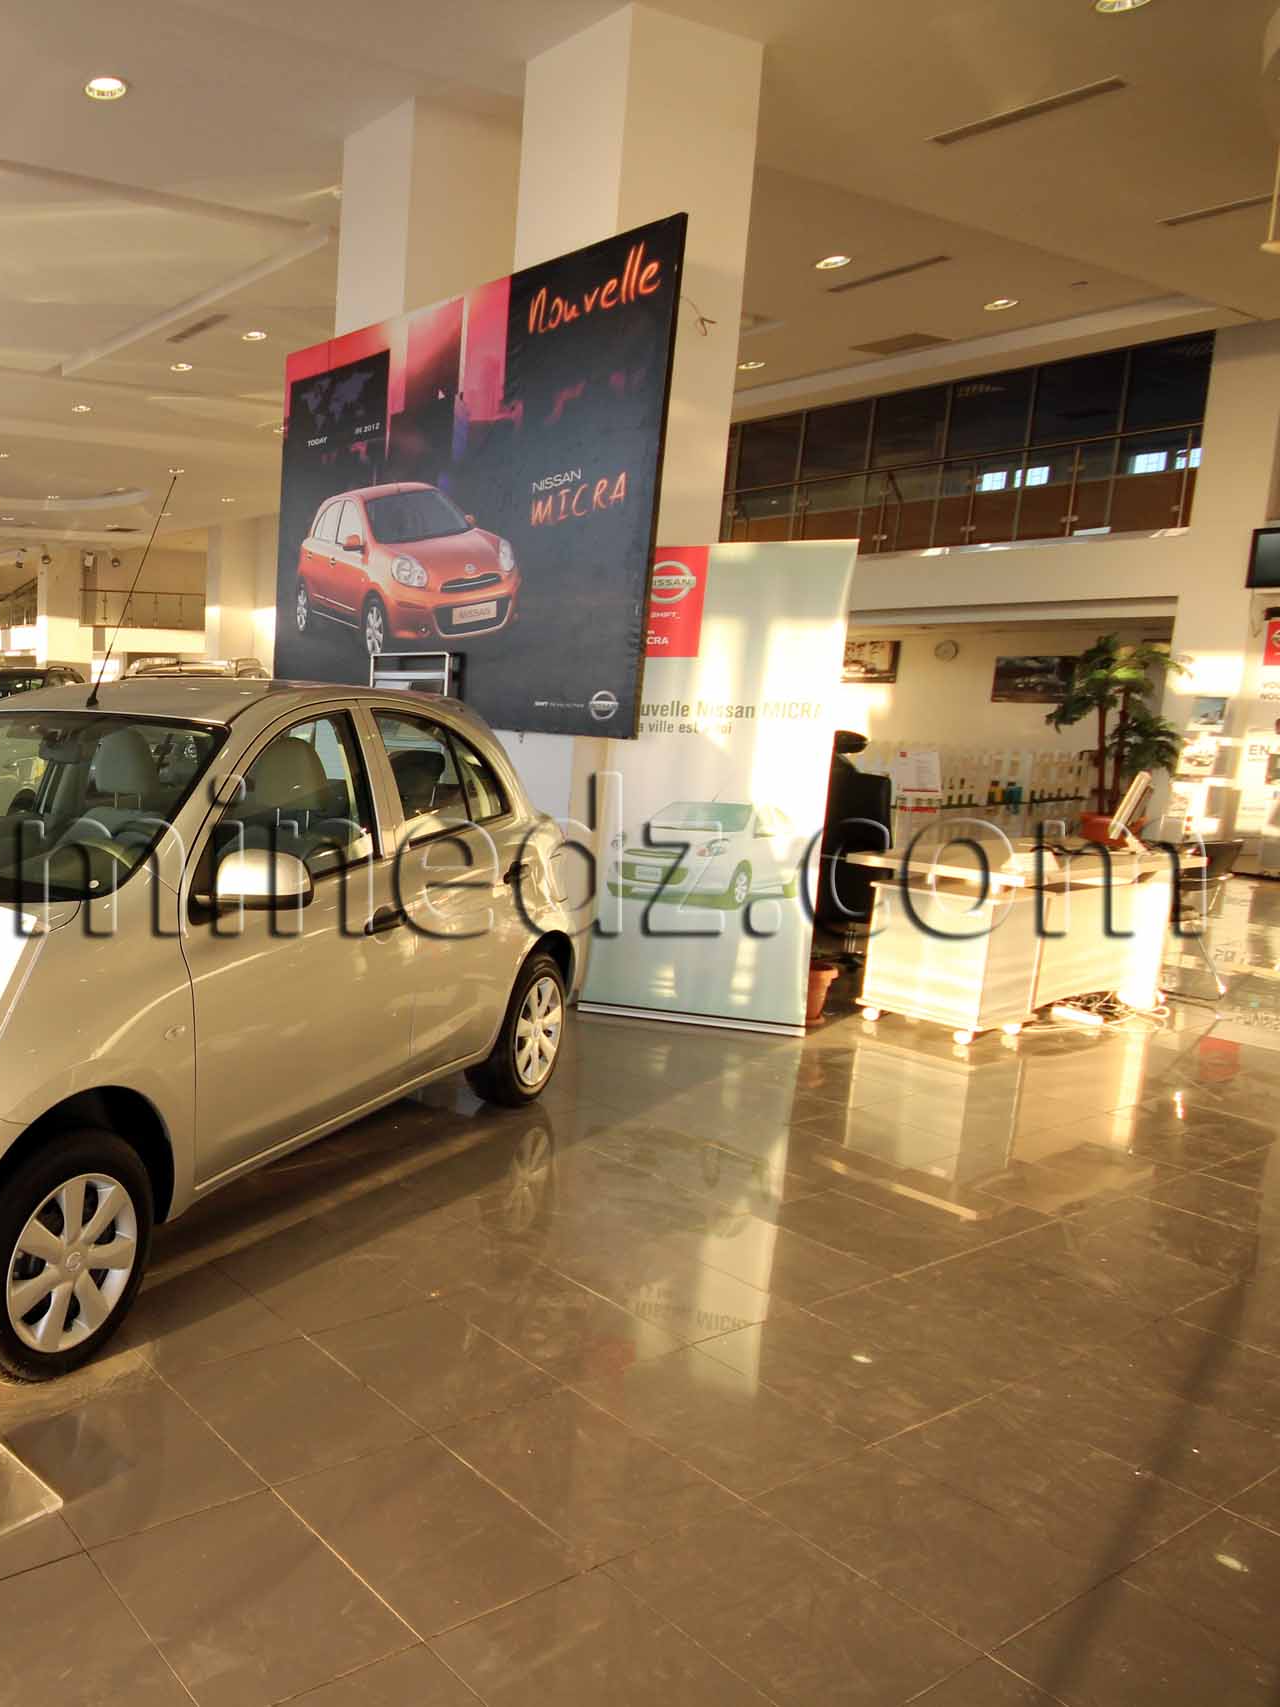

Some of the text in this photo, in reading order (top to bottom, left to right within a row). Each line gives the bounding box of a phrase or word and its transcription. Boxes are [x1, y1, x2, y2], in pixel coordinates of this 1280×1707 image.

[531, 467, 582, 494] NISSAN
[529, 470, 627, 528] MICRA
[646, 636, 669, 646] CRA
[640, 700, 690, 718] uvelle
[648, 719, 674, 733] ville
